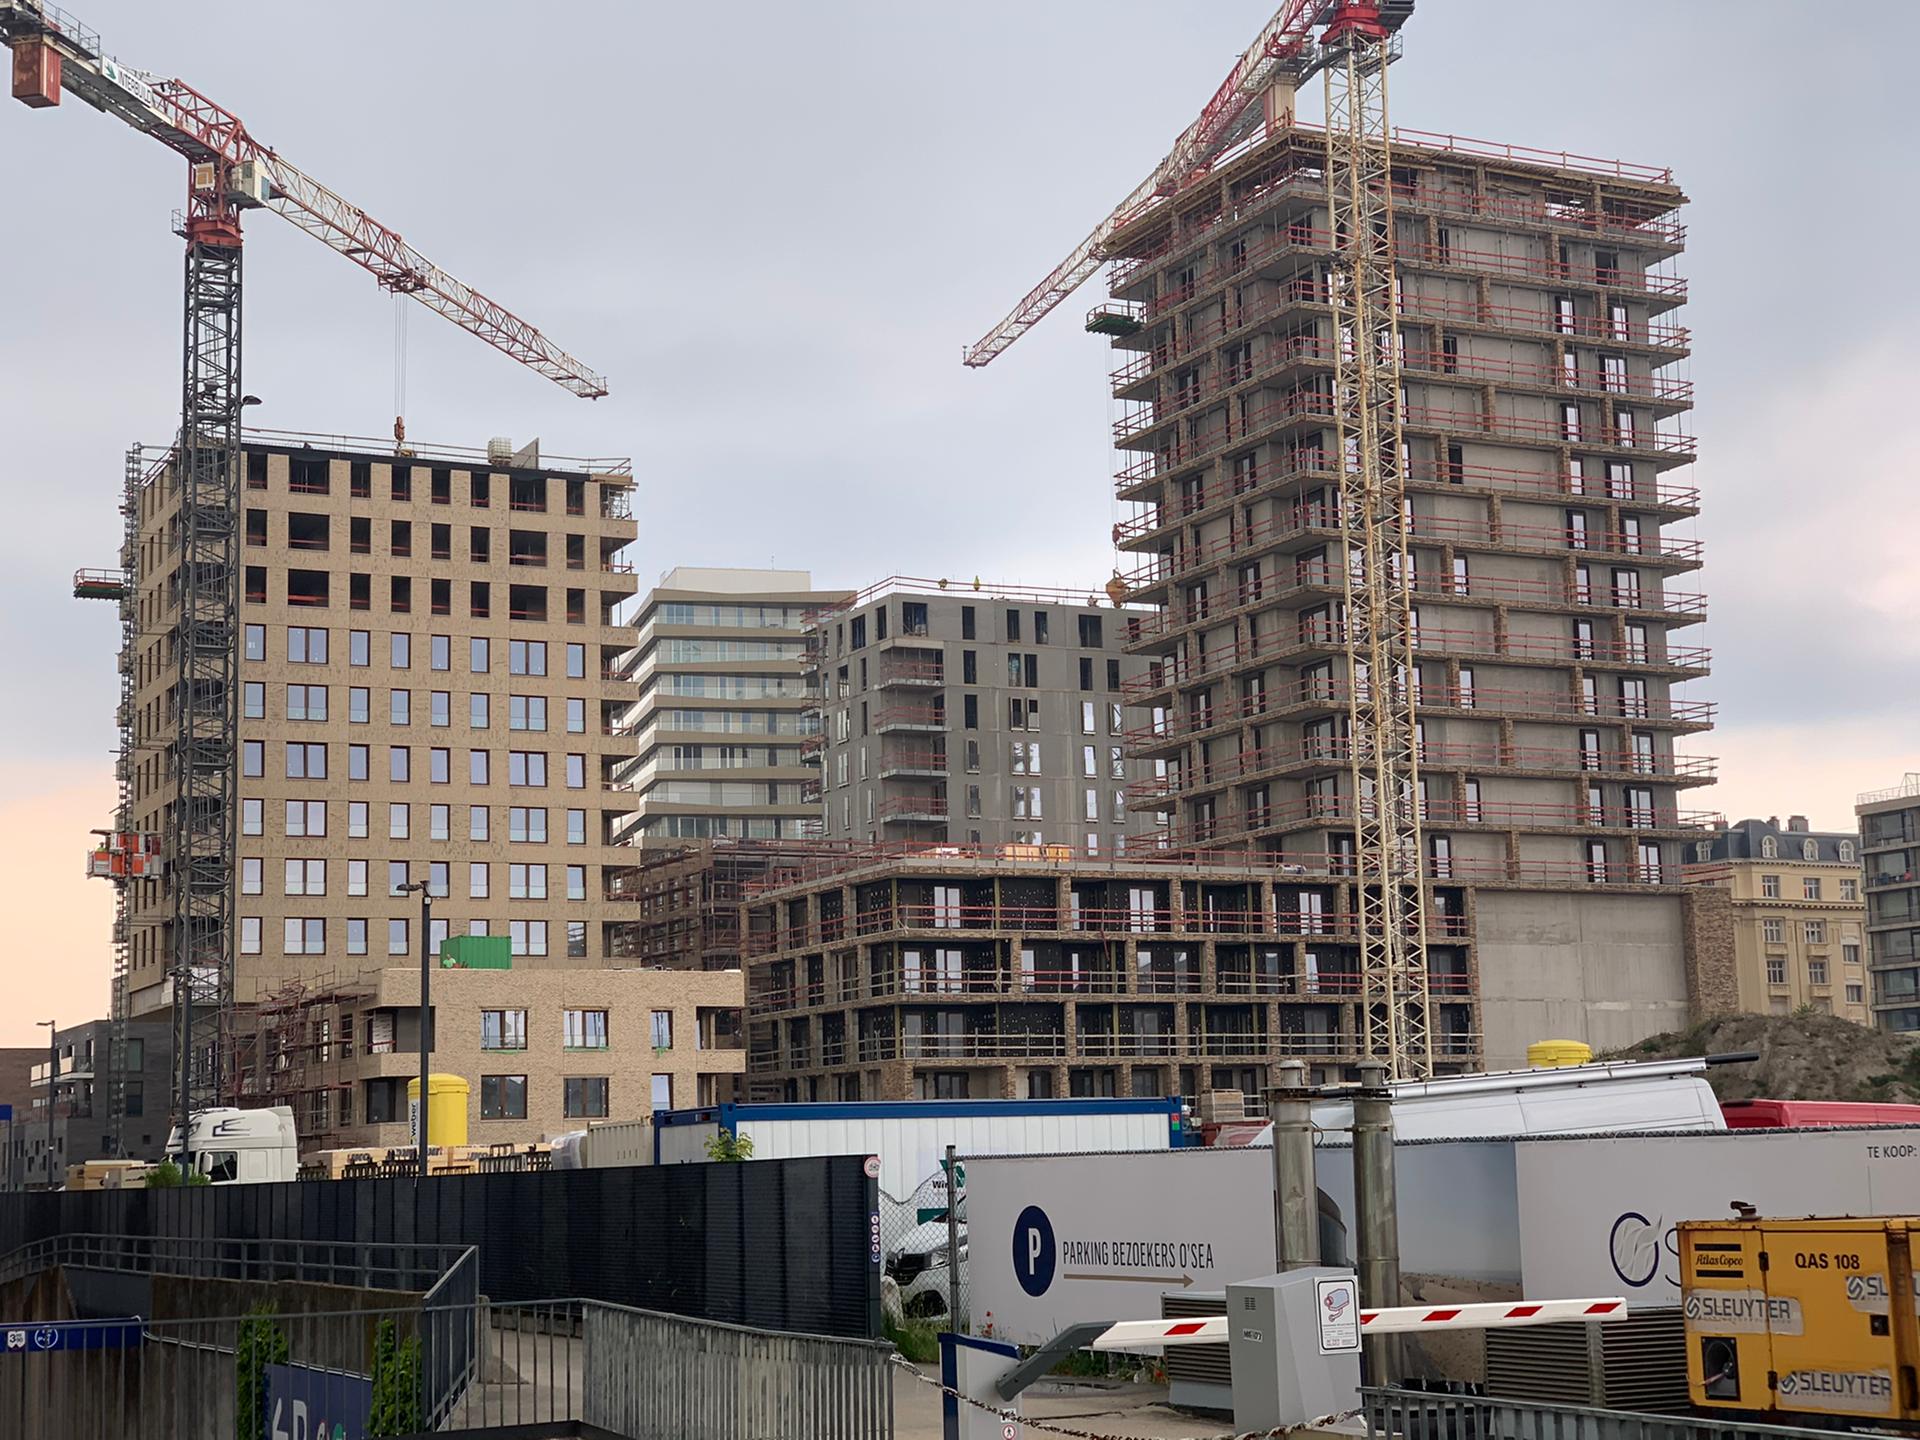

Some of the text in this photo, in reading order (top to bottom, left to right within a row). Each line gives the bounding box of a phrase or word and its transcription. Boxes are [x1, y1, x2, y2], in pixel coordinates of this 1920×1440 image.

[1867, 1145, 1918, 1158] TE KOOP:
[1028, 1228, 1042, 1275] P
[1063, 1241, 1214, 1269] PARKING BEZOEKERS O'SEA
[1695, 1254, 1744, 1268] Atlas Copco
[1795, 1252, 1861, 1269] QAS 108
[1702, 1297, 1791, 1319] SLEUYTER
[1800, 1372, 1892, 1396] SLEUYTER
